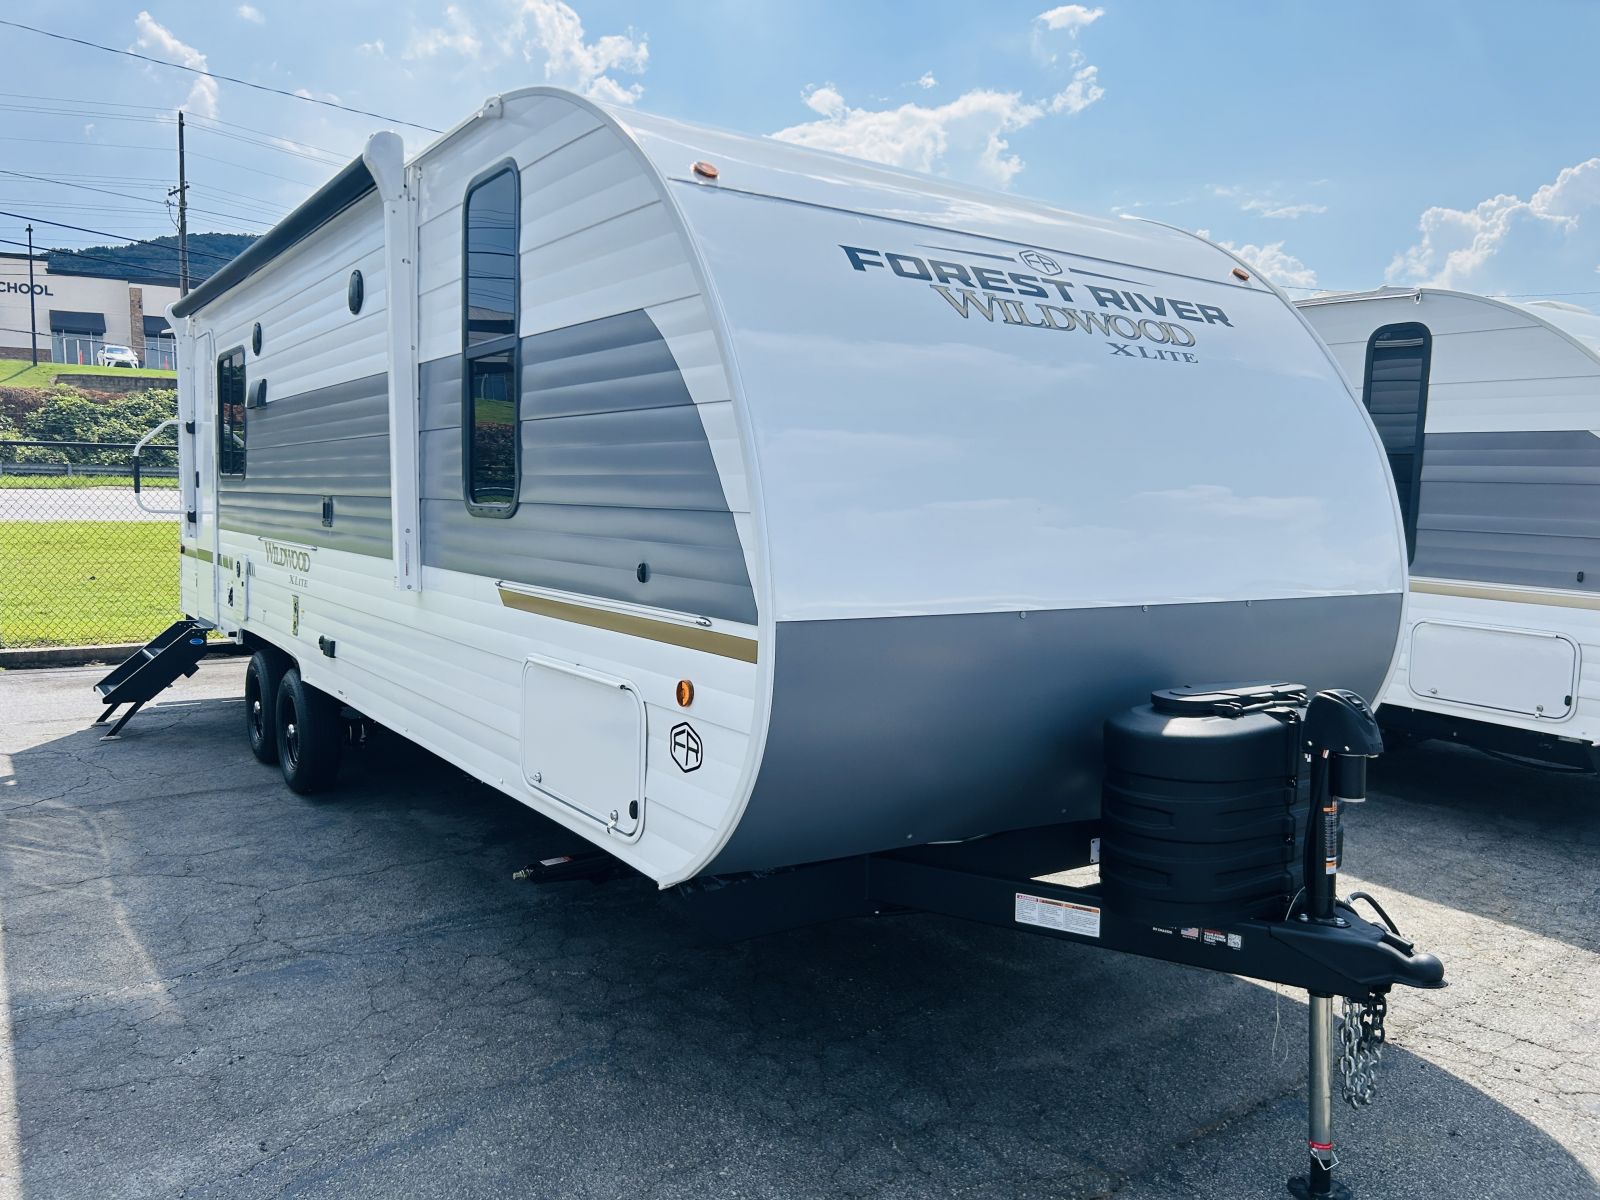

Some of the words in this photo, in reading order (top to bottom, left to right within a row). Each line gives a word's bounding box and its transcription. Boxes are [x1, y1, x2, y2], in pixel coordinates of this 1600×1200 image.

[838, 244, 1074, 302] FOREST
[1084, 284, 1235, 328] RIVER
[929, 284, 1197, 348] WILDWOOD
[265, 541, 311, 572] WILDWOOD
